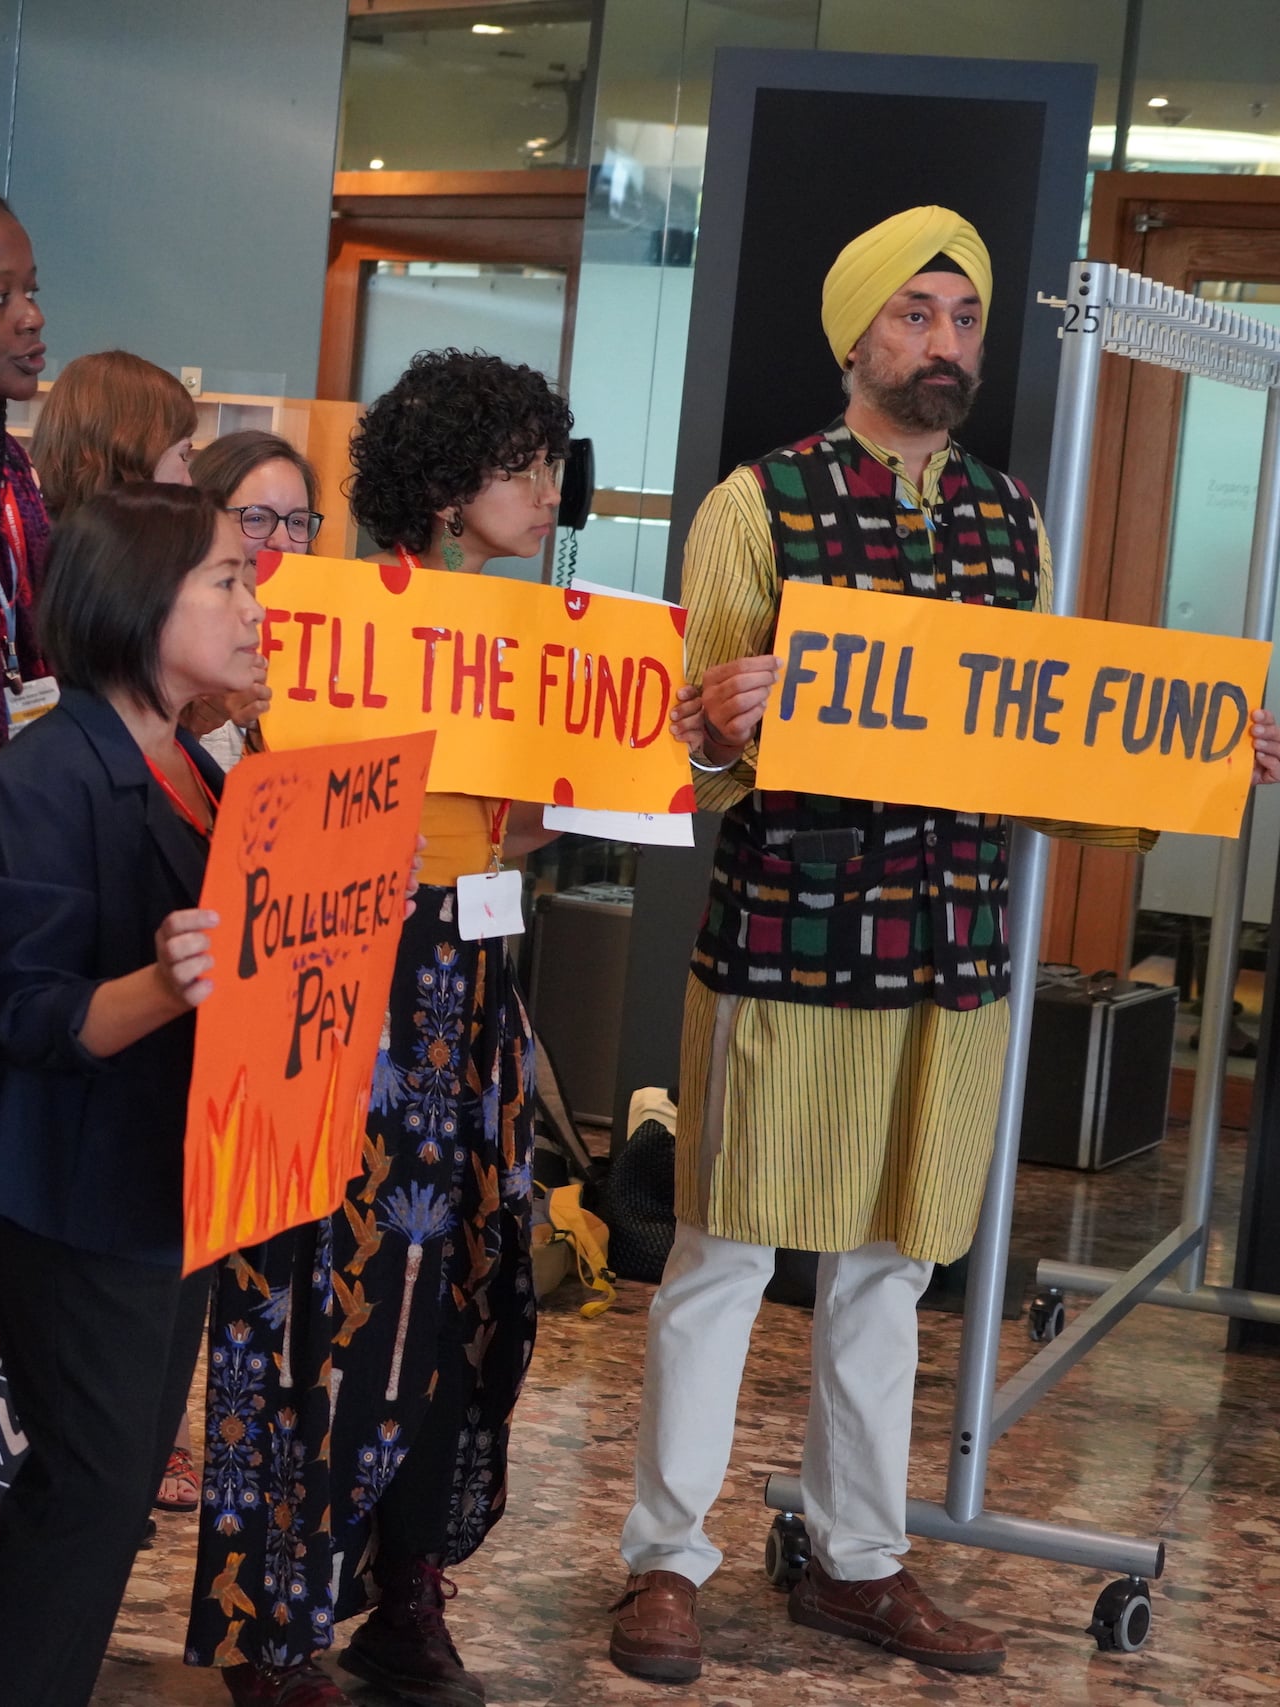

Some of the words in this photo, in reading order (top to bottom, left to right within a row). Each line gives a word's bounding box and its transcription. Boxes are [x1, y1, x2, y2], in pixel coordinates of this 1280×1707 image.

[1065, 304, 1101, 333] 25
[262, 606, 387, 708] FILL
[412, 626, 519, 721] THE
[539, 643, 672, 748] FUND
[779, 630, 928, 730] FILL
[959, 652, 1070, 745] THE
[1084, 666, 1249, 763] FUND
[323, 754, 401, 831] MAKE
[284, 966, 361, 1080] PAY
